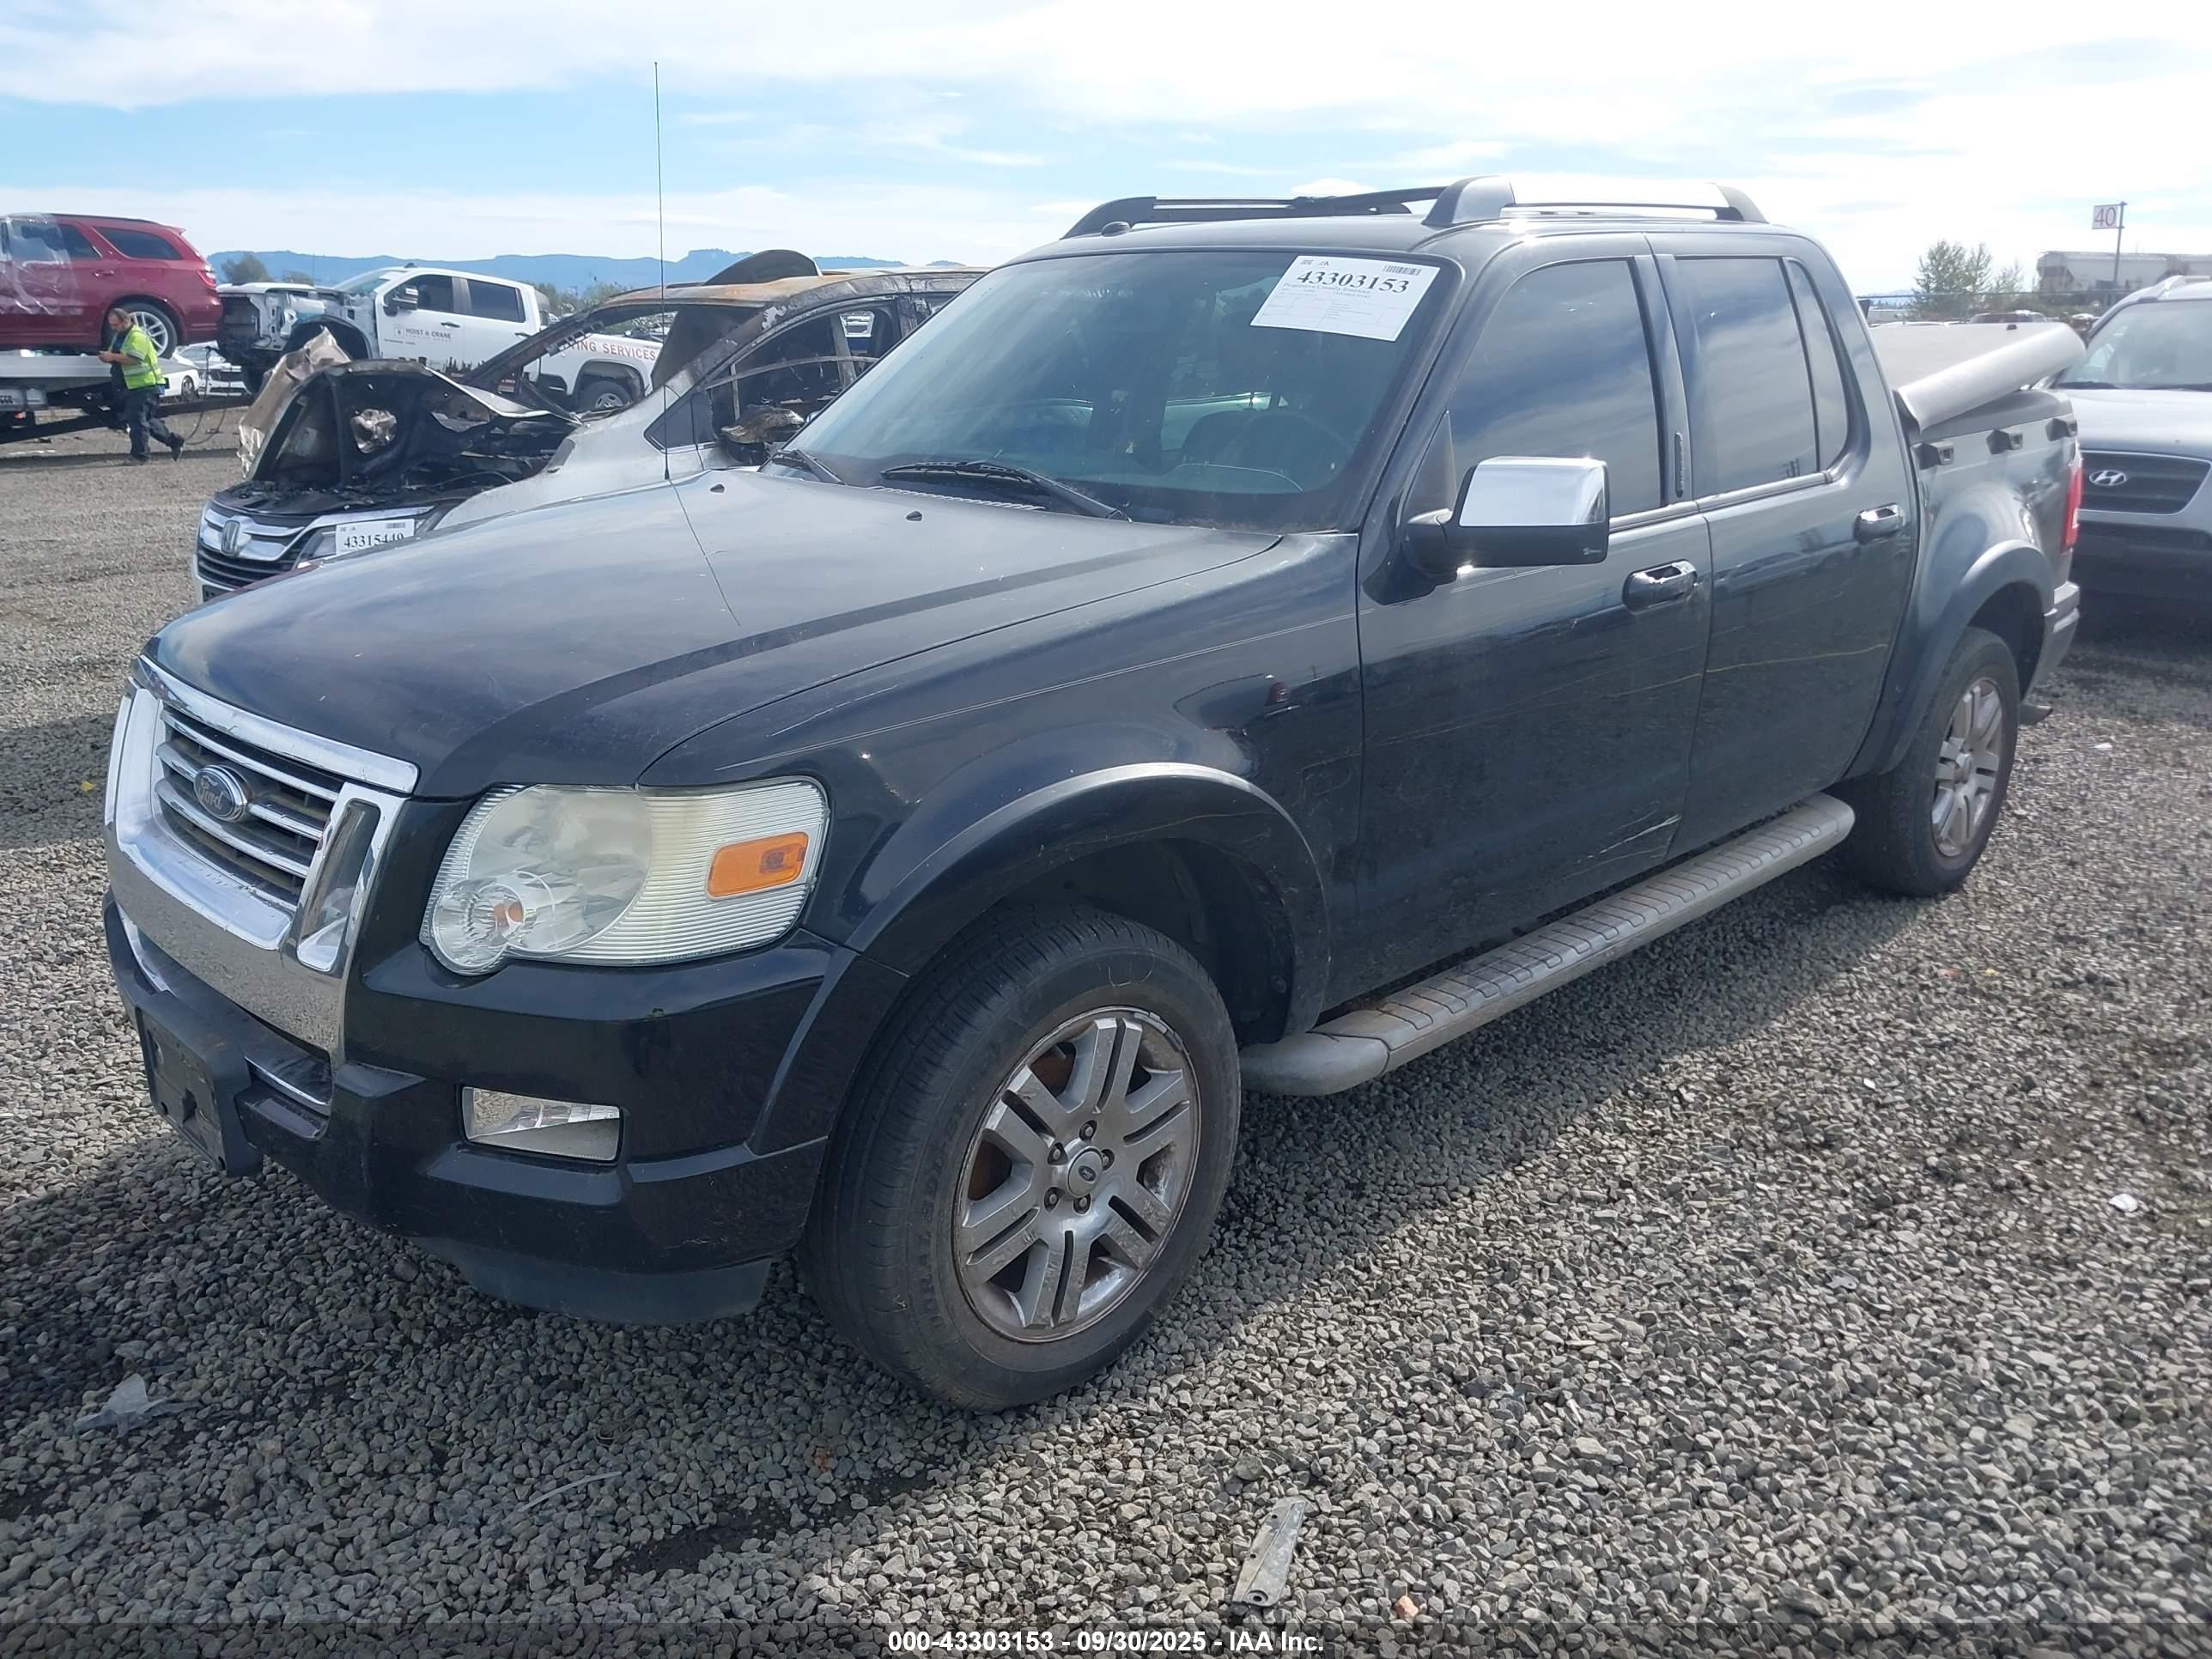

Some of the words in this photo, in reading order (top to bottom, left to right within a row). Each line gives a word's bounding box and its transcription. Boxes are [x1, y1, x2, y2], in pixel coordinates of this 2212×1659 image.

[2094, 207, 2117, 227] 40
[1297, 270, 1410, 294] 43303153
[431, 331, 451, 339] CRANE
[603, 343, 656, 361] SERVICES
[198, 775, 224, 810] Ford
